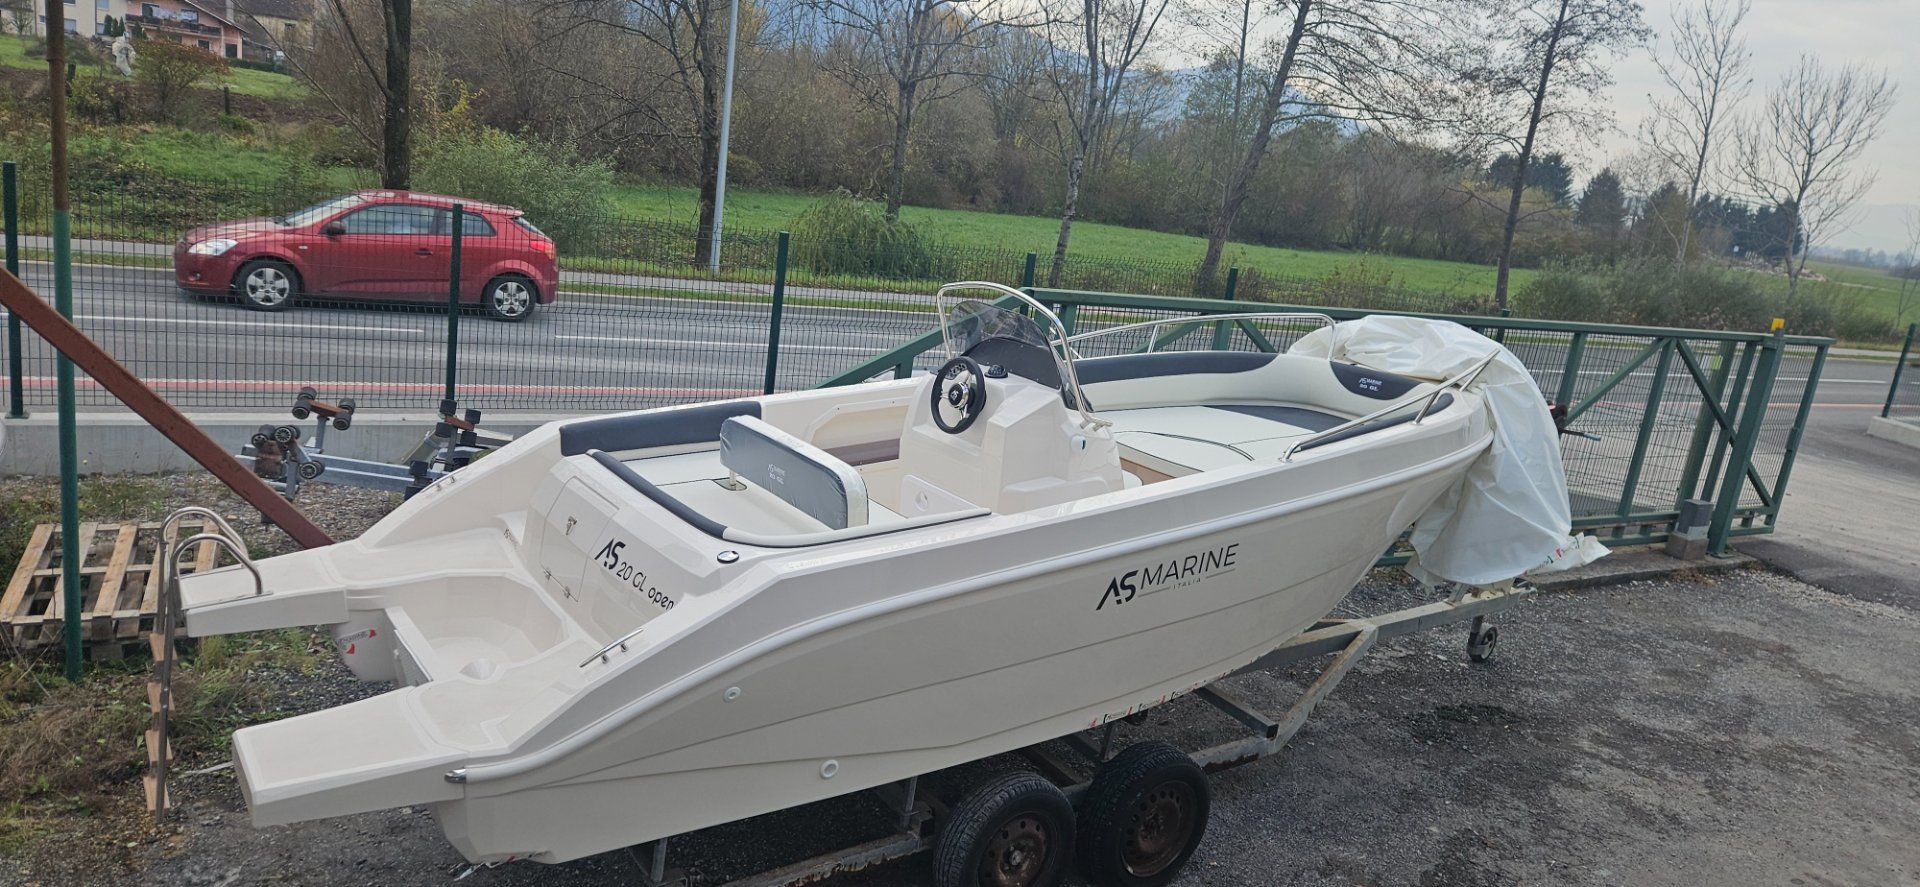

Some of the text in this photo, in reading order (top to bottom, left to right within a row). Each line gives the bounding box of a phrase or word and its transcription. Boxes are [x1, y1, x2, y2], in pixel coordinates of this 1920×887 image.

[594, 538, 675, 610] AS 20 GL open
[1096, 543, 1240, 611] AS MARINE
[1173, 576, 1201, 590] ITALIA
